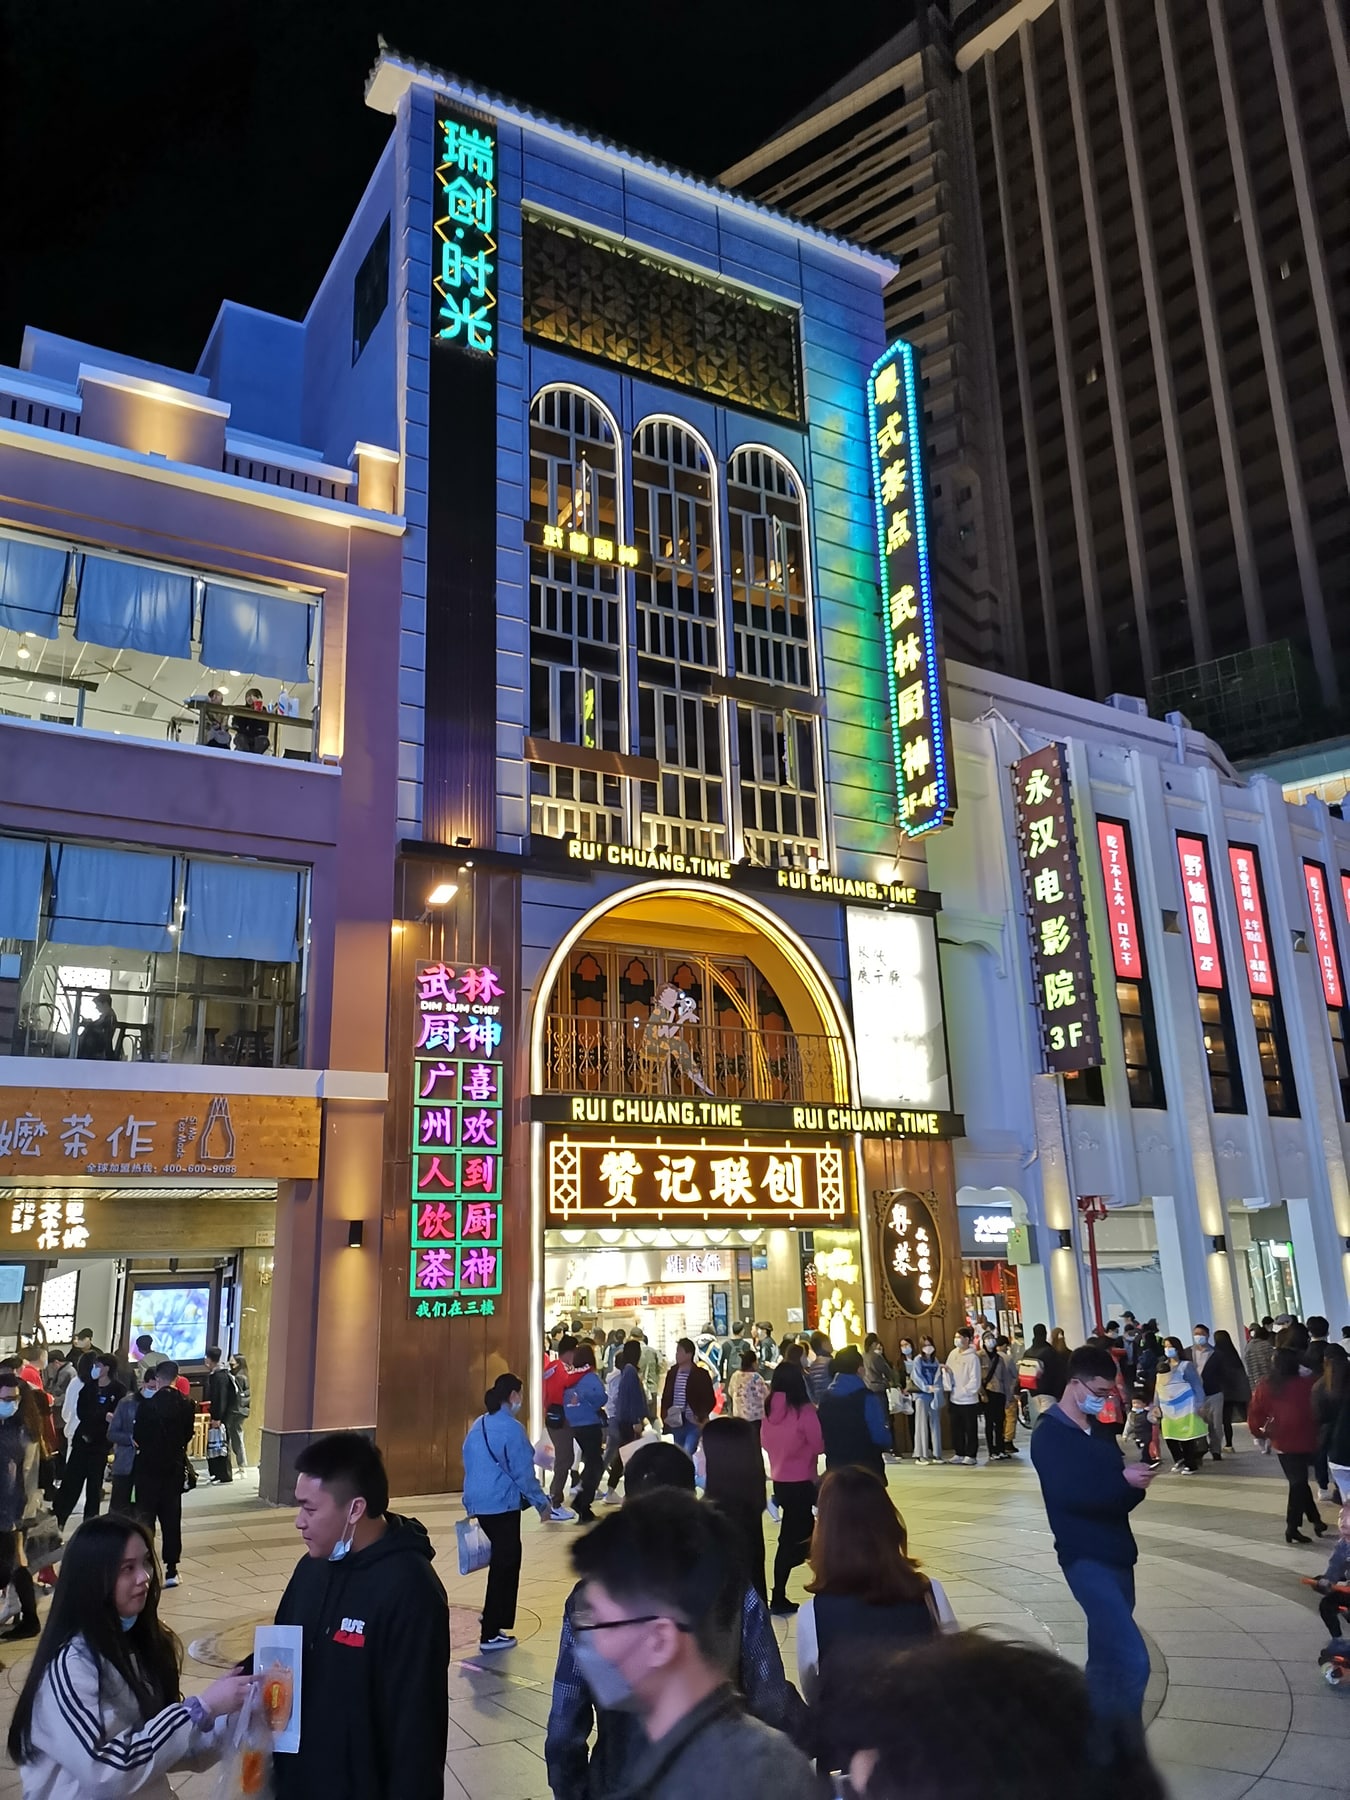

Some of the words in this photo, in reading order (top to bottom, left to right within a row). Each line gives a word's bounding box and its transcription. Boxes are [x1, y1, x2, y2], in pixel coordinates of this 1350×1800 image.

[440, 120, 493, 351] 瑞创·时光
[890, 585, 931, 782] 武林厨神
[569, 839, 602, 860] RUI
[777, 869, 807, 890] RUI
[1024, 768, 1077, 1012] 永汉电影院
[417, 963, 505, 1003] 武林
[420, 1000, 442, 1012] DIM
[445, 1002, 471, 1014] SUM
[472, 1004, 500, 1016] CHEF
[416, 1014, 502, 1058] 厨神
[1050, 1022, 1083, 1051] 3F
[571, 1097, 607, 1122] RUI
[612, 1099, 742, 1127] CHUANG.TIME
[793, 1107, 823, 1130] RUI
[417, 1062, 455, 1290] 广州人饮茶
[462, 1063, 497, 1288] 喜欢到厨神
